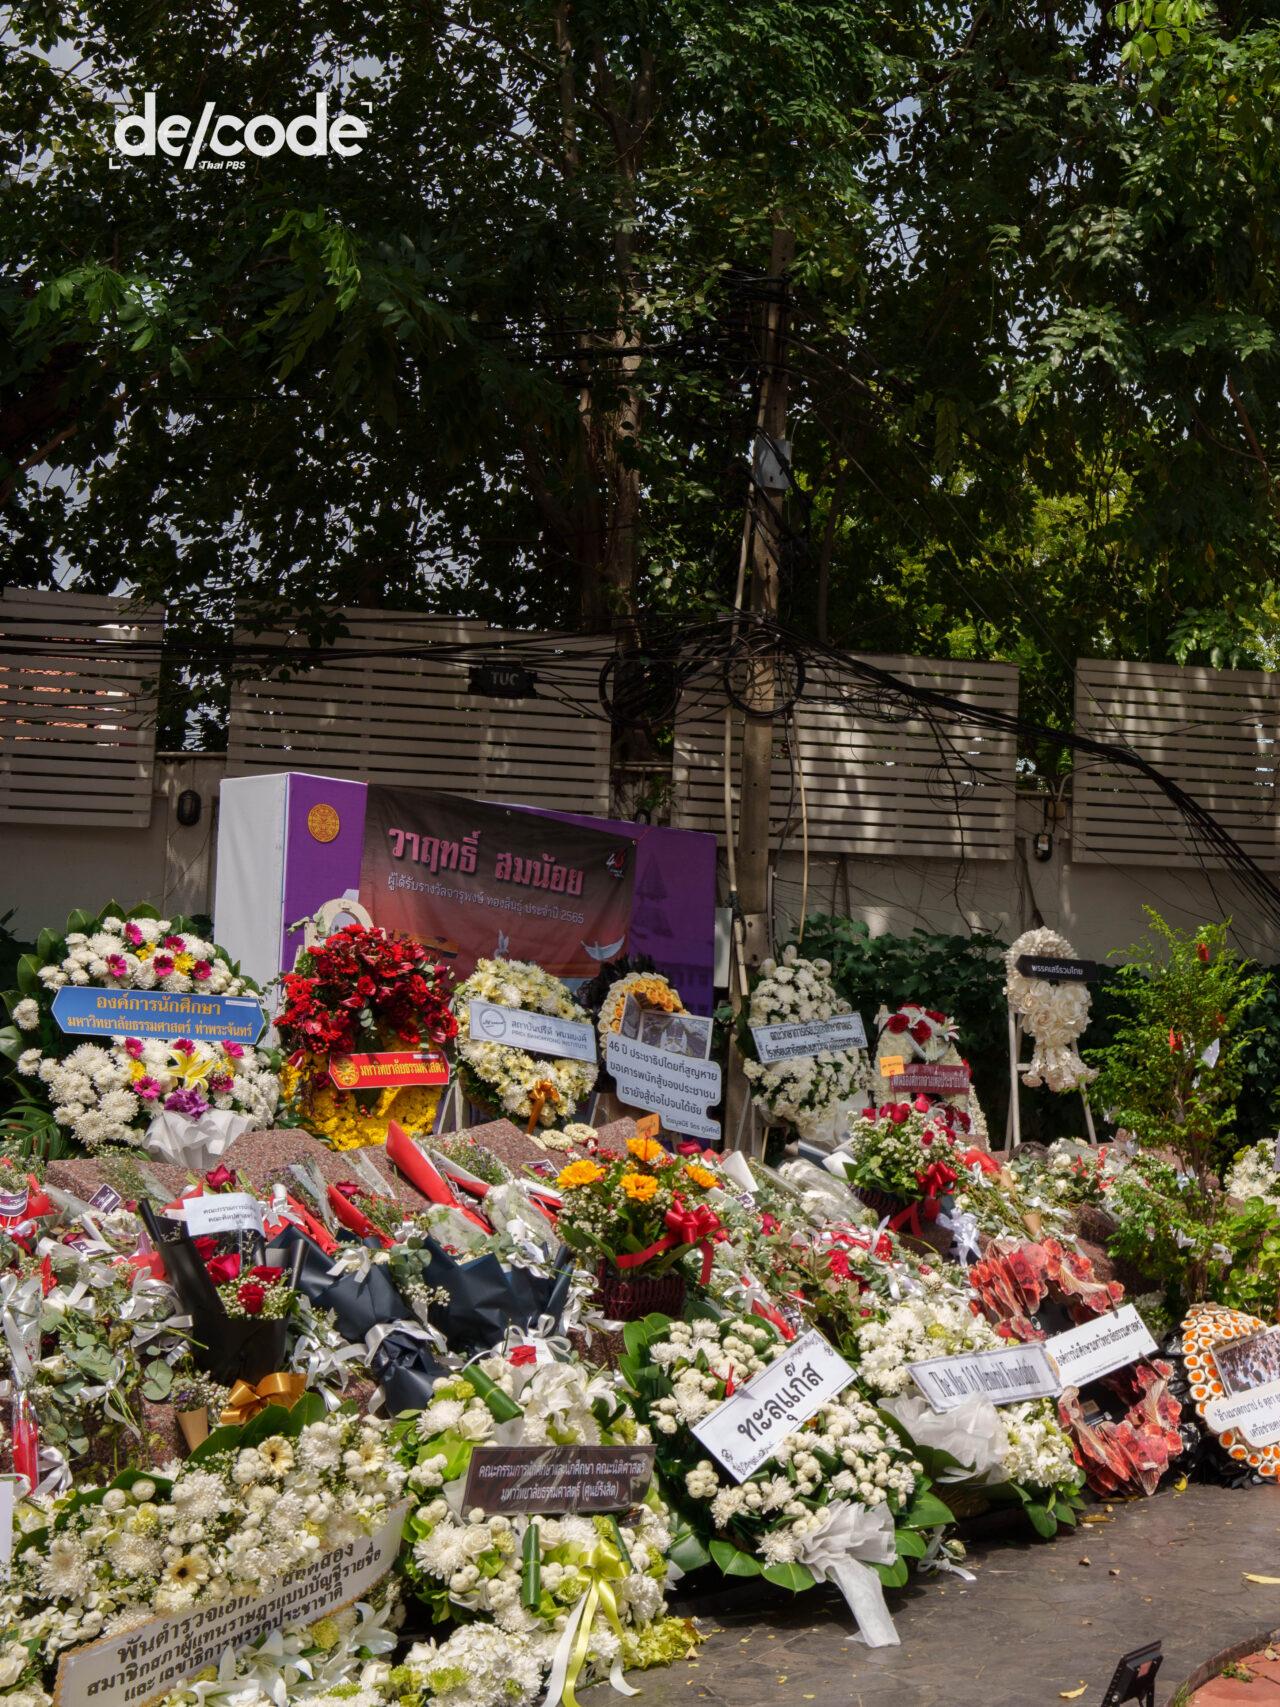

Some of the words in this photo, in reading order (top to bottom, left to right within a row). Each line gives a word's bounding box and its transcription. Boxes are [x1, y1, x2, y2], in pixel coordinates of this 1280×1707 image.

[491, 672, 519, 686] TUC
[388, 830, 481, 874] วาฤทธิ์
[495, 853, 584, 896] สมน้อย
[560, 910, 584, 924] 2565
[96, 993, 221, 1015] องค์การนักศึกษา
[67, 1015, 191, 1035] มหาวิทยาลัยธรรมศาสตร์
[195, 1021, 253, 1037] ท่าพระจันทร์
[360, 1058, 445, 1076] มหาวิทยาลัยธรรมศาสตร์
[609, 1041, 620, 1053] 46
[622, 1043, 628, 1055] ปี
[630, 1048, 718, 1080] ประชาธิปไตยที่สูญหาย
[610, 1061, 716, 1099] ขอเคารพนักสู้ของประชาชน
[622, 1085, 702, 1115] เรายังสู้ต่อไปจนได้ชัย
[928, 1371, 956, 1397] The
[971, 1362, 1009, 1391] Memorial
[737, 1362, 824, 1442] ทะลุแก๊ส
[596, 1459, 646, 1476] คณะนิติศาสตร์
[282, 1543, 354, 1590] สอดสอง
[87, 1541, 382, 1697] สมาชิกสภาผู้แทนราษฎรแบบบัญชีรายชื่อ
[124, 1675, 156, 1702] และ
